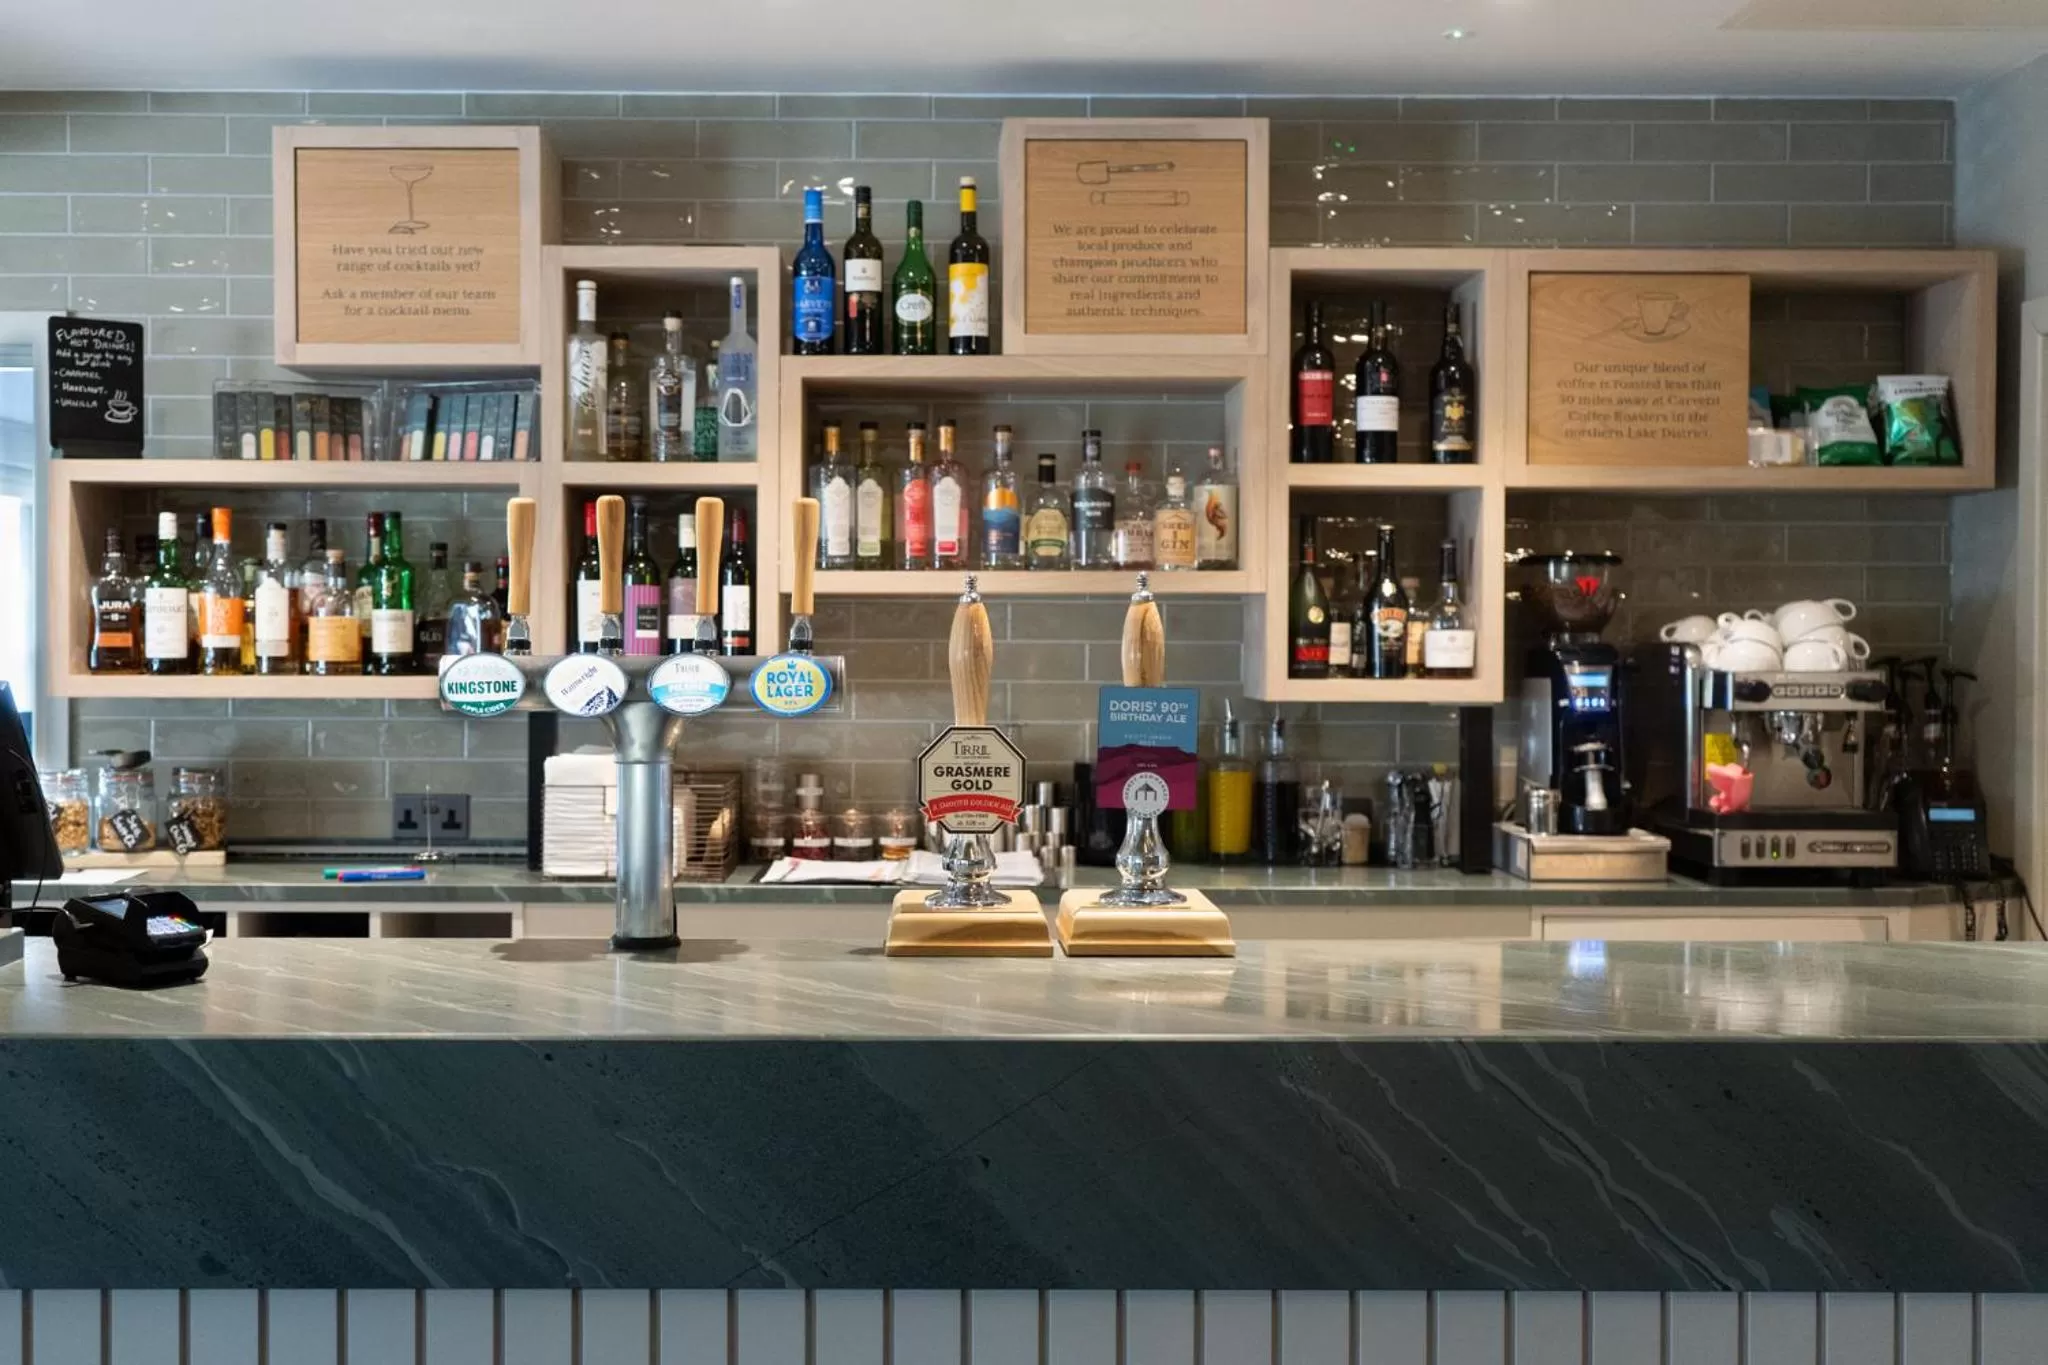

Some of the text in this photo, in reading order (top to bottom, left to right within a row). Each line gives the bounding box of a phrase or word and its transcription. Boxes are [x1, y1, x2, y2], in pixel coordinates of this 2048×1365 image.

[1052, 223, 1218, 237] We are proud to celebrate
[332, 244, 484, 258] Have you tried our new
[1077, 240, 1193, 253] local produce and
[336, 260, 481, 274] range of cocktails yet?
[1052, 256, 1219, 270] champion producers who
[1052, 273, 1219, 285] share our commitment to
[322, 288, 345, 300] Ask
[360, 288, 415, 300] member
[419, 288, 432, 300] of
[435, 291, 458, 300] our
[462, 290, 497, 300] team
[1070, 289, 1201, 304] real ingredients and
[344, 304, 362, 316] for
[378, 304, 431, 316] cocktail
[1066, 305, 1125, 318] authentic
[1573, 361, 1706, 377] Our unique blend of
[1556, 378, 1722, 391] coffee is roasted less than
[1578, 395, 1613, 406] miles
[1616, 396, 1649, 408] away
[1651, 395, 1665, 406] at
[1568, 410, 1709, 422] Coffee Roasters in the
[1564, 427, 1624, 439] northern
[1627, 426, 1657, 439] Lake
[99, 600, 131, 610] JURA
[766, 671, 814, 684] ROYAL
[447, 680, 518, 695] KINGSTONE
[766, 685, 814, 698] LAGER
[1109, 700, 1157, 713] DORIS'
[1109, 713, 1188, 723] BIRTHDAY ALE
[933, 766, 1011, 778] GRASMERE
[951, 779, 993, 791] GOLD
